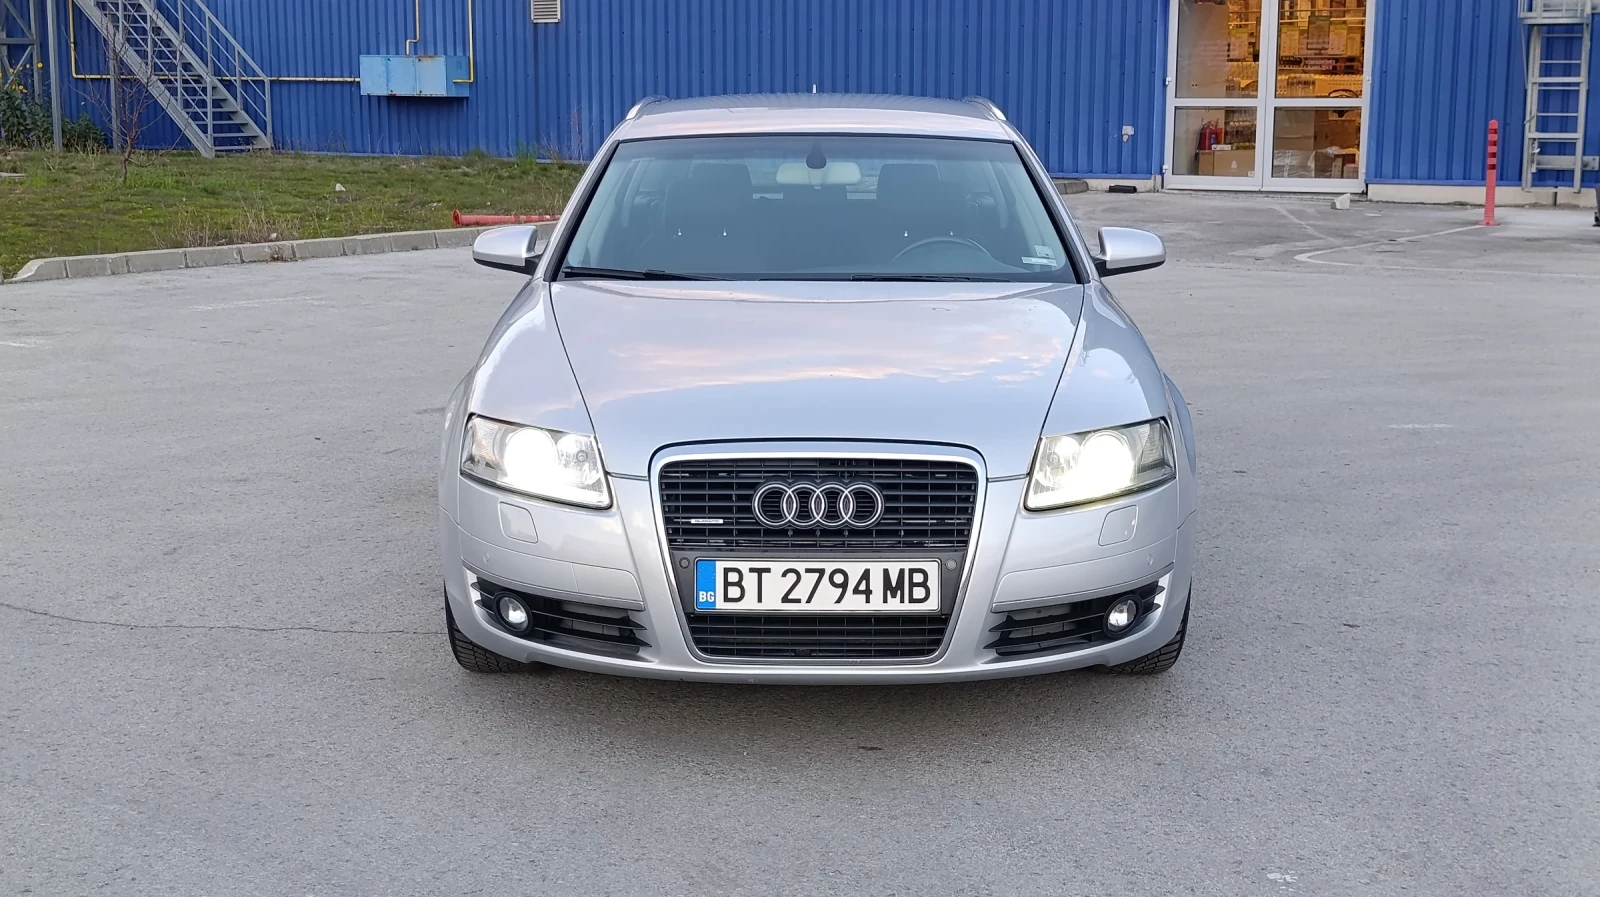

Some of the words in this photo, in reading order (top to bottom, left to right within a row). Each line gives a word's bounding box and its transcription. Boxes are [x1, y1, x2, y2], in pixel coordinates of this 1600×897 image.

[699, 591, 715, 602] BG
[723, 567, 771, 603] BT
[781, 568, 873, 604] 2794
[883, 568, 931, 604] MB
